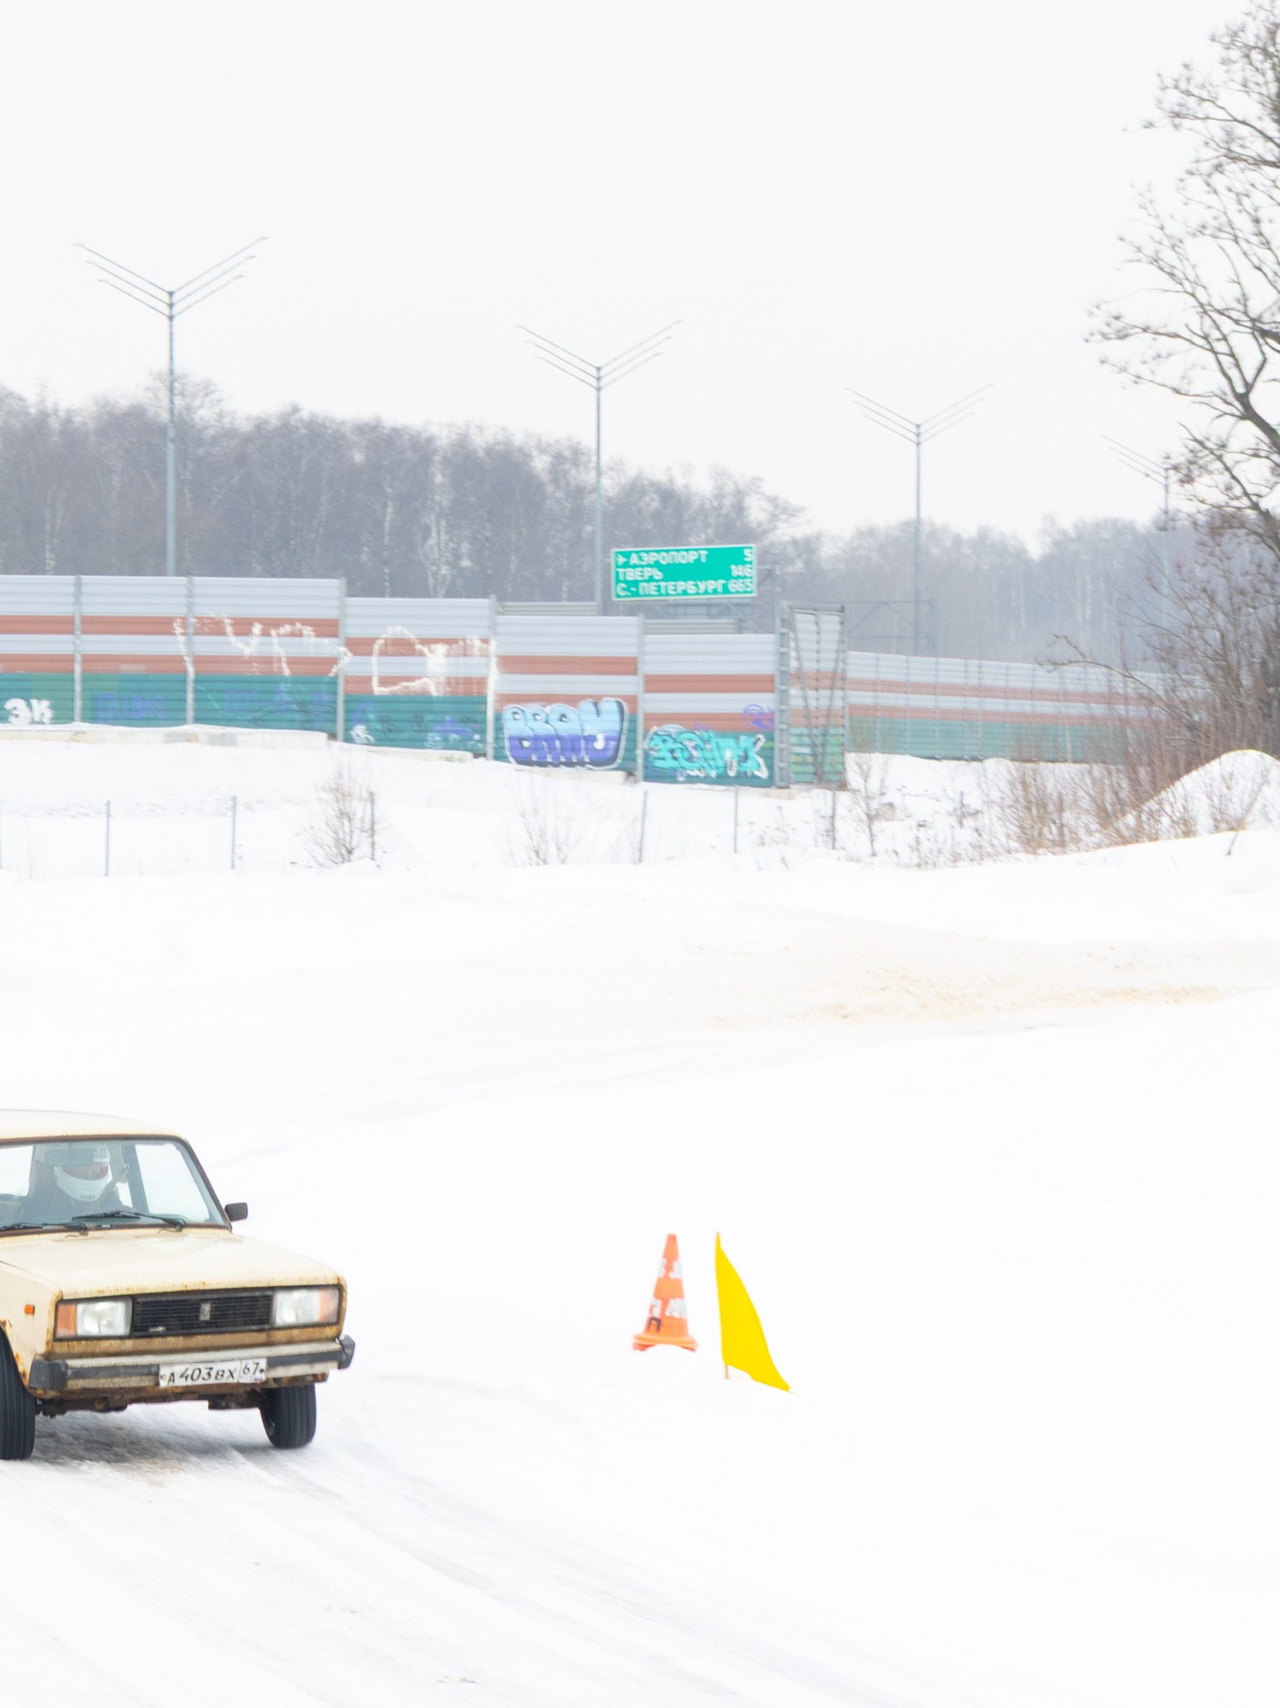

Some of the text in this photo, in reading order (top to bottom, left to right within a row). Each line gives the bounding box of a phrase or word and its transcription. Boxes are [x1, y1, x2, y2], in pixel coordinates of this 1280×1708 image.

[629, 550, 709, 565] АЭРОПОРТ
[616, 567, 664, 581] ТВЕРЬ
[242, 1361, 260, 1376] 67
